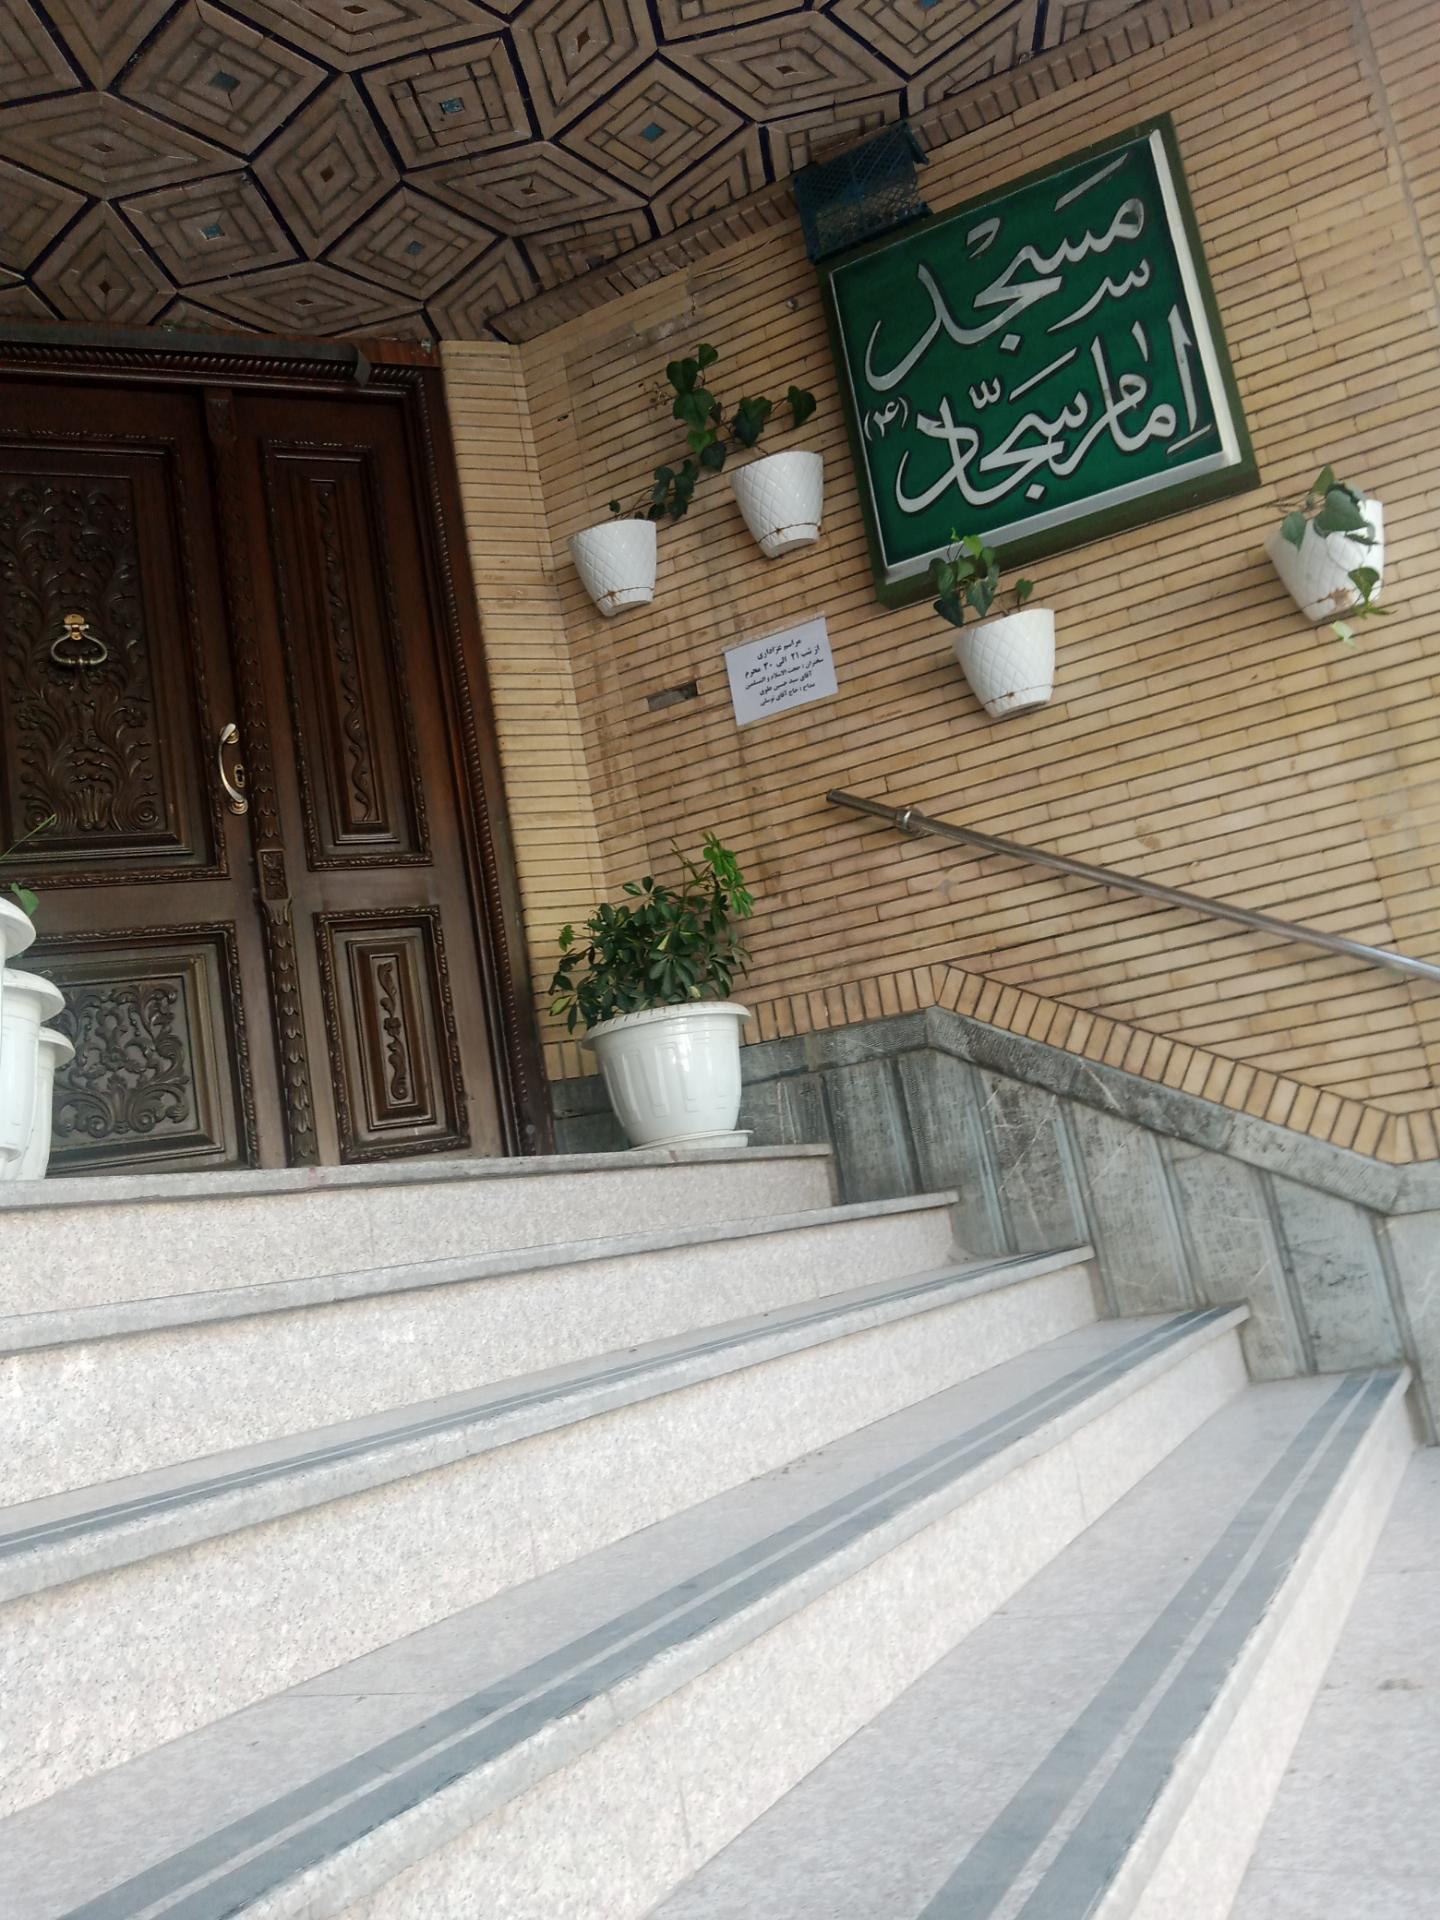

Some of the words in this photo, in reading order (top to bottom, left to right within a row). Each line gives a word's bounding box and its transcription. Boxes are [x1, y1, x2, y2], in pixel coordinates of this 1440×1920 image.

[1049, 304, 1198, 476] امام
[783, 639, 802, 651] مراسم
[757, 645, 783, 660] عزاداری
[801, 647, 812, 657] شب
[776, 656, 787, 668] الی
[745, 668, 761, 679] محرم
